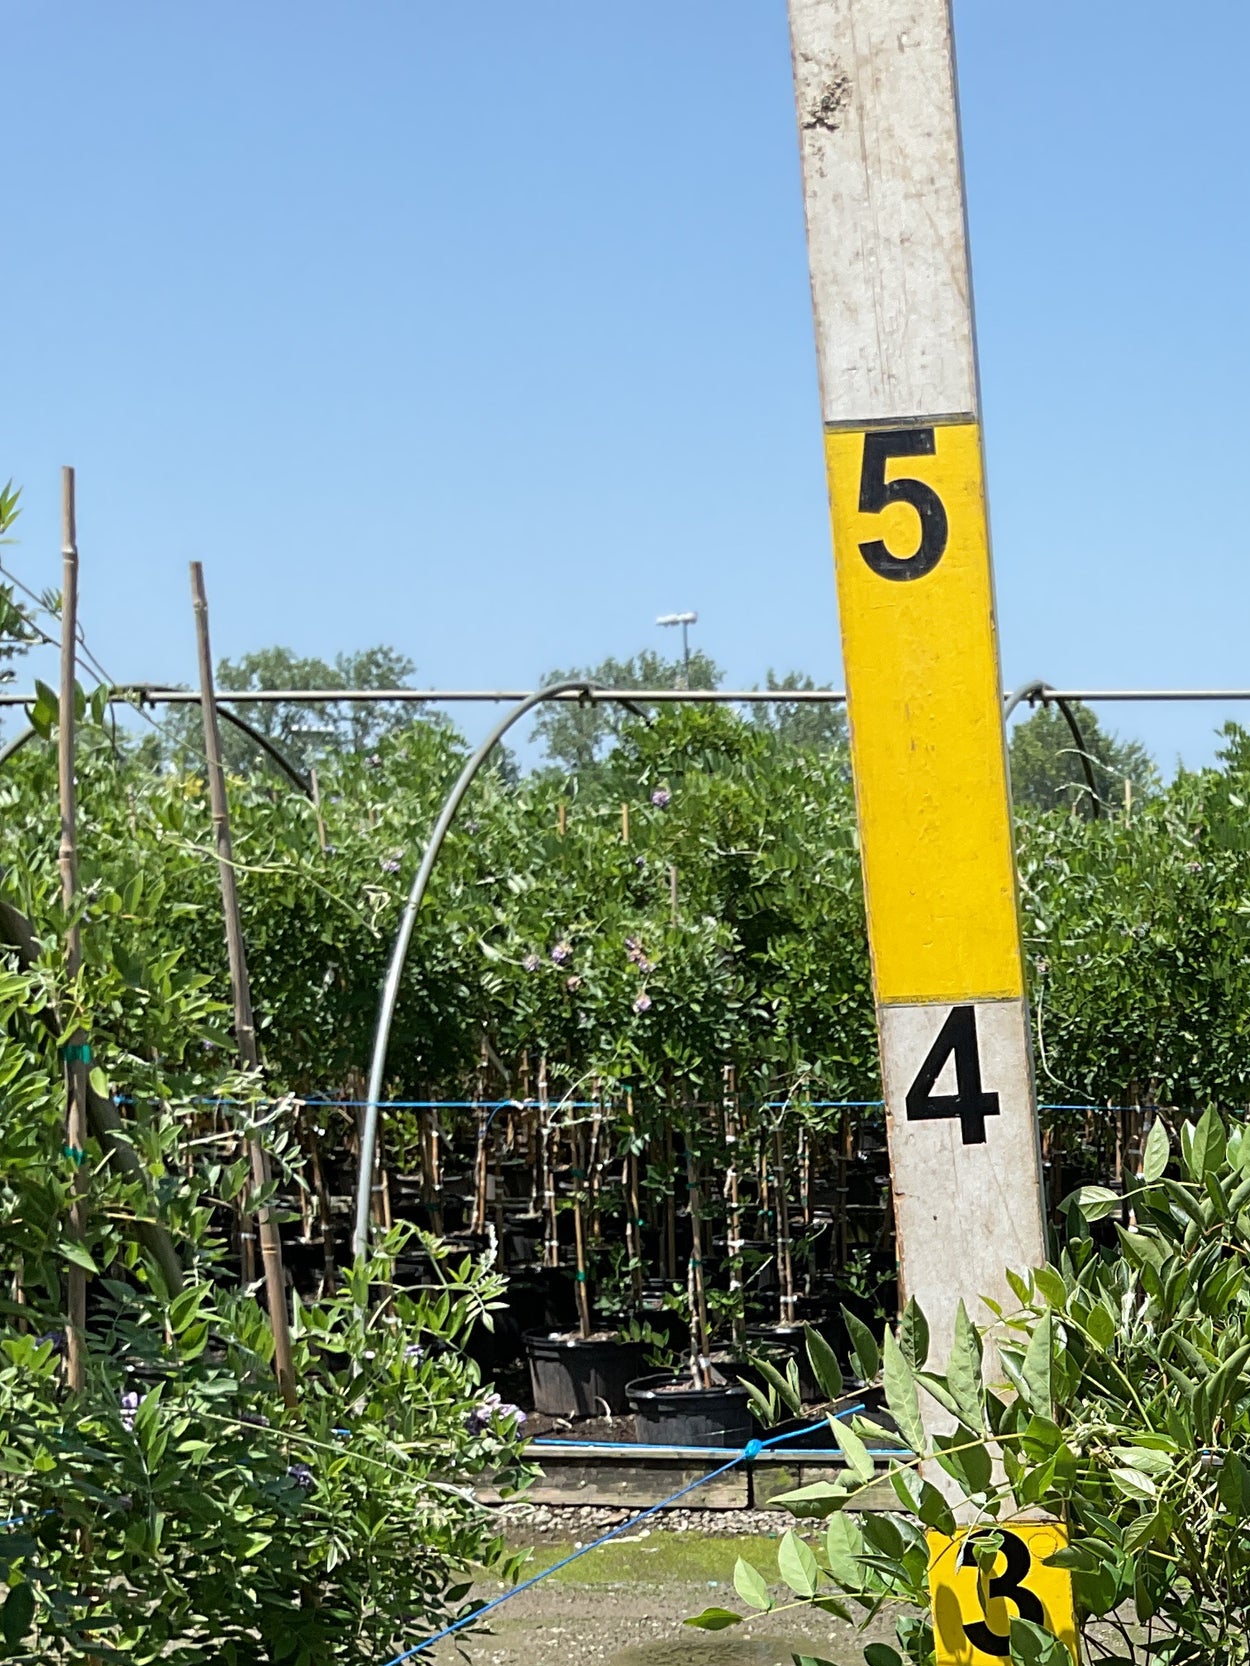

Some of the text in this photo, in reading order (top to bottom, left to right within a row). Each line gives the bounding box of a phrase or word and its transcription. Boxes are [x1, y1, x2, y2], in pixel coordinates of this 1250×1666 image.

[858, 429, 948, 581] 5
[905, 1006, 999, 1144] 4
[963, 1529, 1044, 1656] 3
